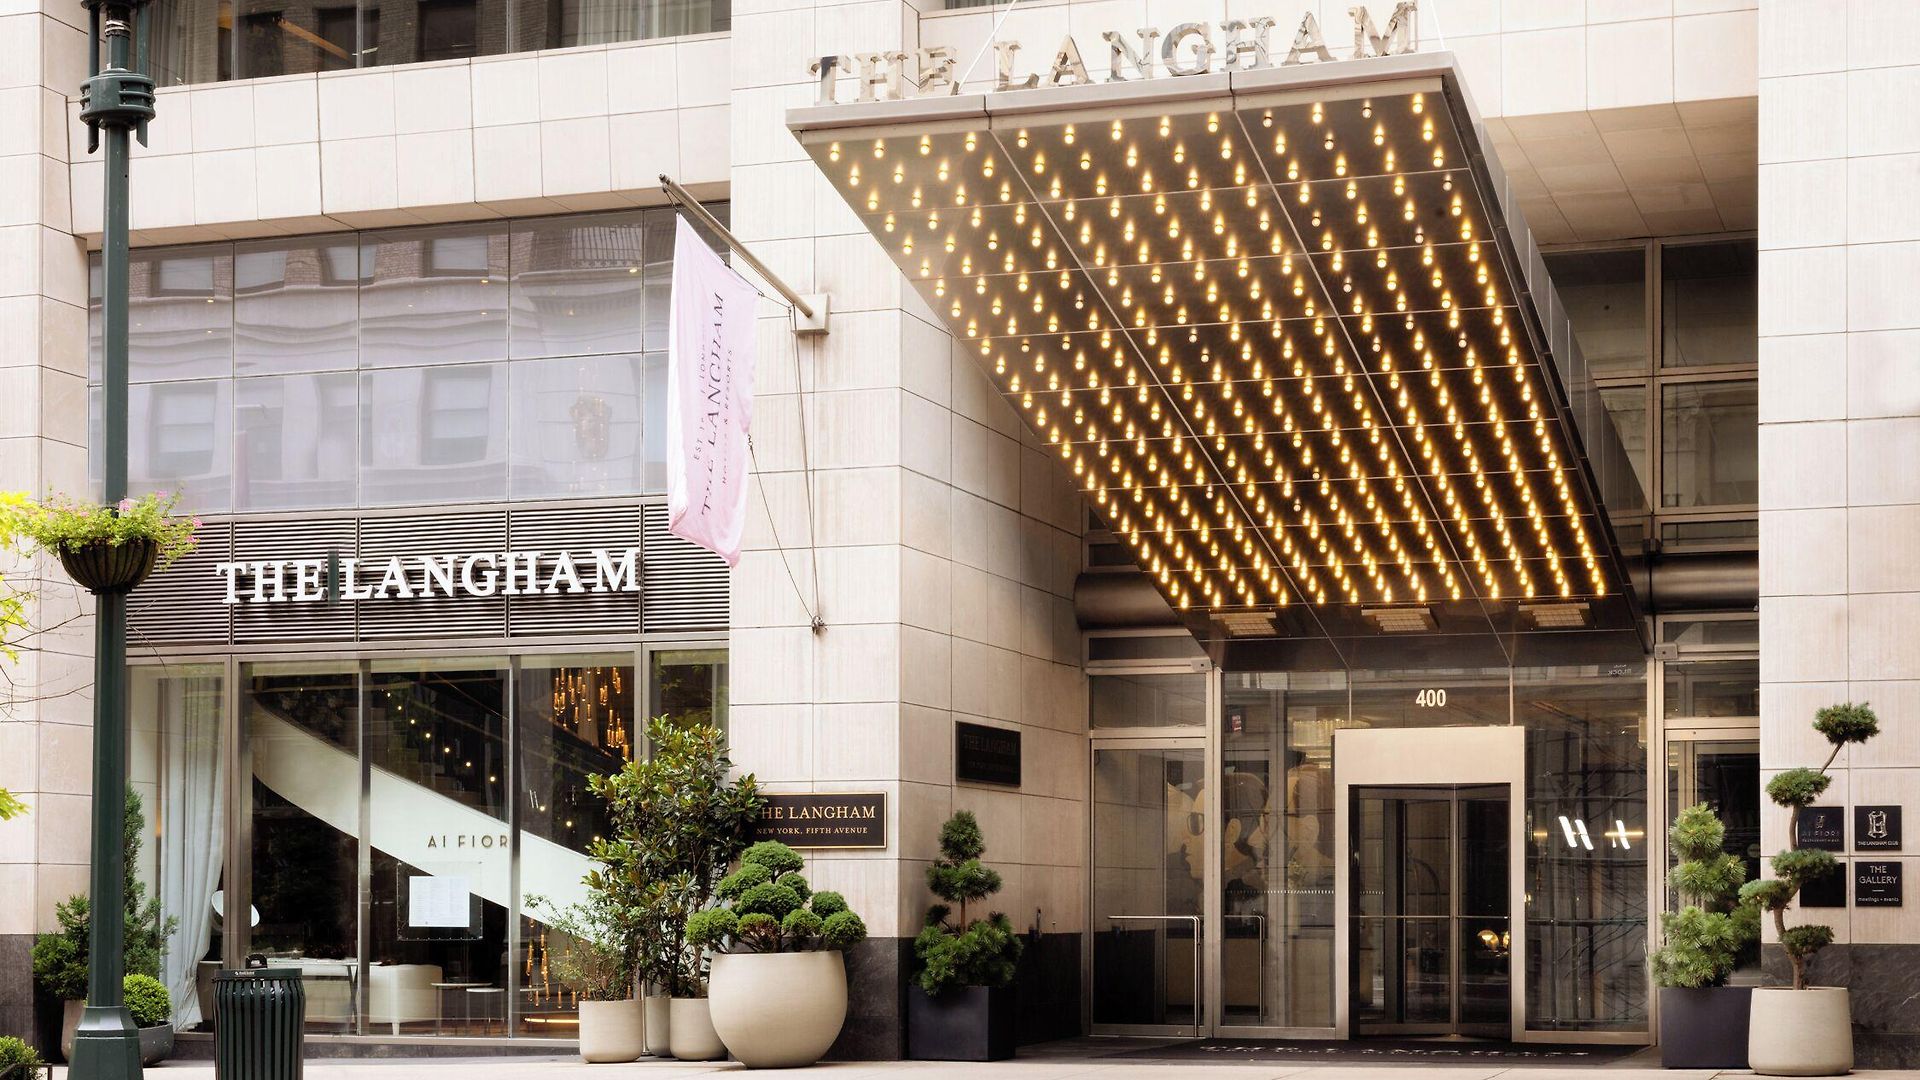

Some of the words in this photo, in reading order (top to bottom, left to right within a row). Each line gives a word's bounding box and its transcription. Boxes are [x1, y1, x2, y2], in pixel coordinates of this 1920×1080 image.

[808, 46, 960, 104] THE
[994, 2, 1419, 91] LANGHAM
[707, 292, 724, 446] LANGHAM
[216, 558, 328, 604] THE
[339, 548, 641, 600] LANGHAM
[1415, 689, 1447, 707] 400
[761, 806, 784, 819] HE
[788, 805, 876, 819] LANGHAM
[776, 827, 803, 835] YORK,
[833, 826, 868, 834] AVENUE
[427, 835, 446, 848] AI
[458, 835, 508, 848] FIOR
[1870, 865, 1887, 874] THE
[1859, 875, 1898, 884] GALLERY
